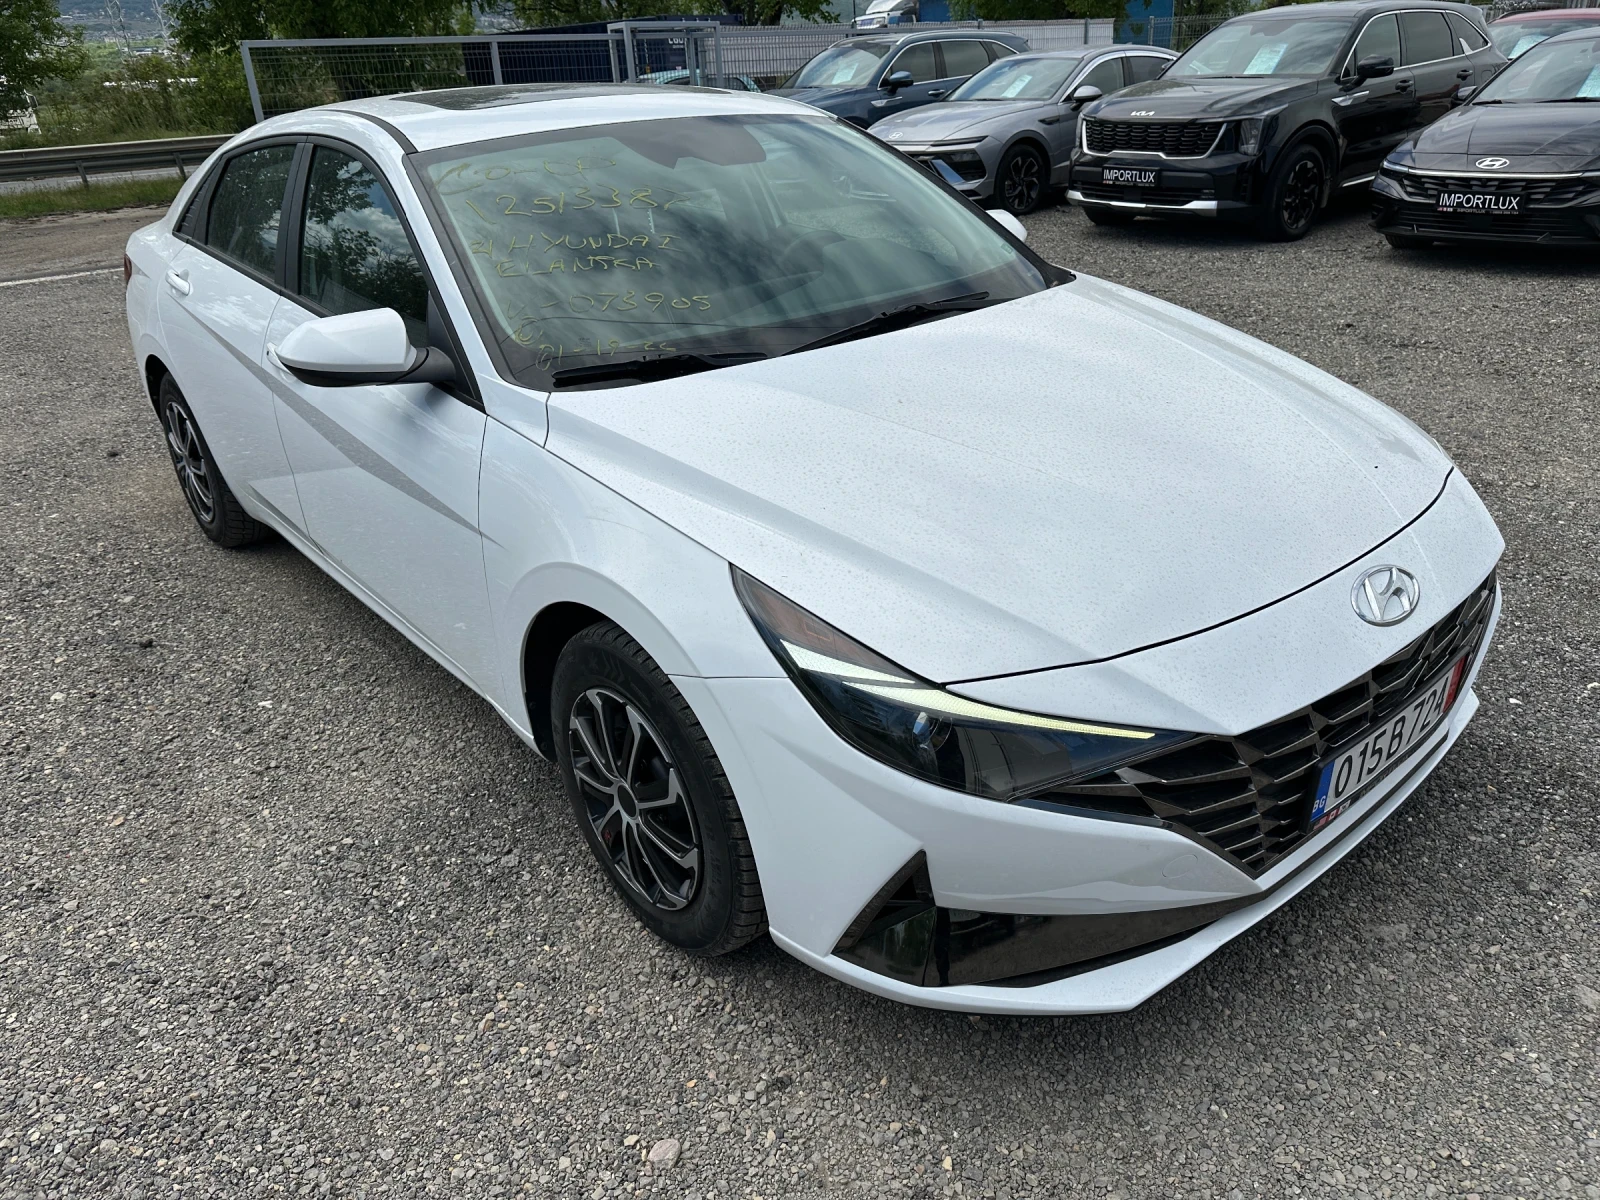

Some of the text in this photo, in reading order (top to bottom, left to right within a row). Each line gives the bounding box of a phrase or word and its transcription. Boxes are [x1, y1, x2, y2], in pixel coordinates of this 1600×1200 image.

[1103, 169, 1156, 183] IMPORTLUX
[1439, 193, 1520, 210] IMPORTLUX
[507, 231, 683, 254] HYUNDAI
[496, 255, 662, 278] ELANTRA
[1312, 795, 1327, 813] BG
